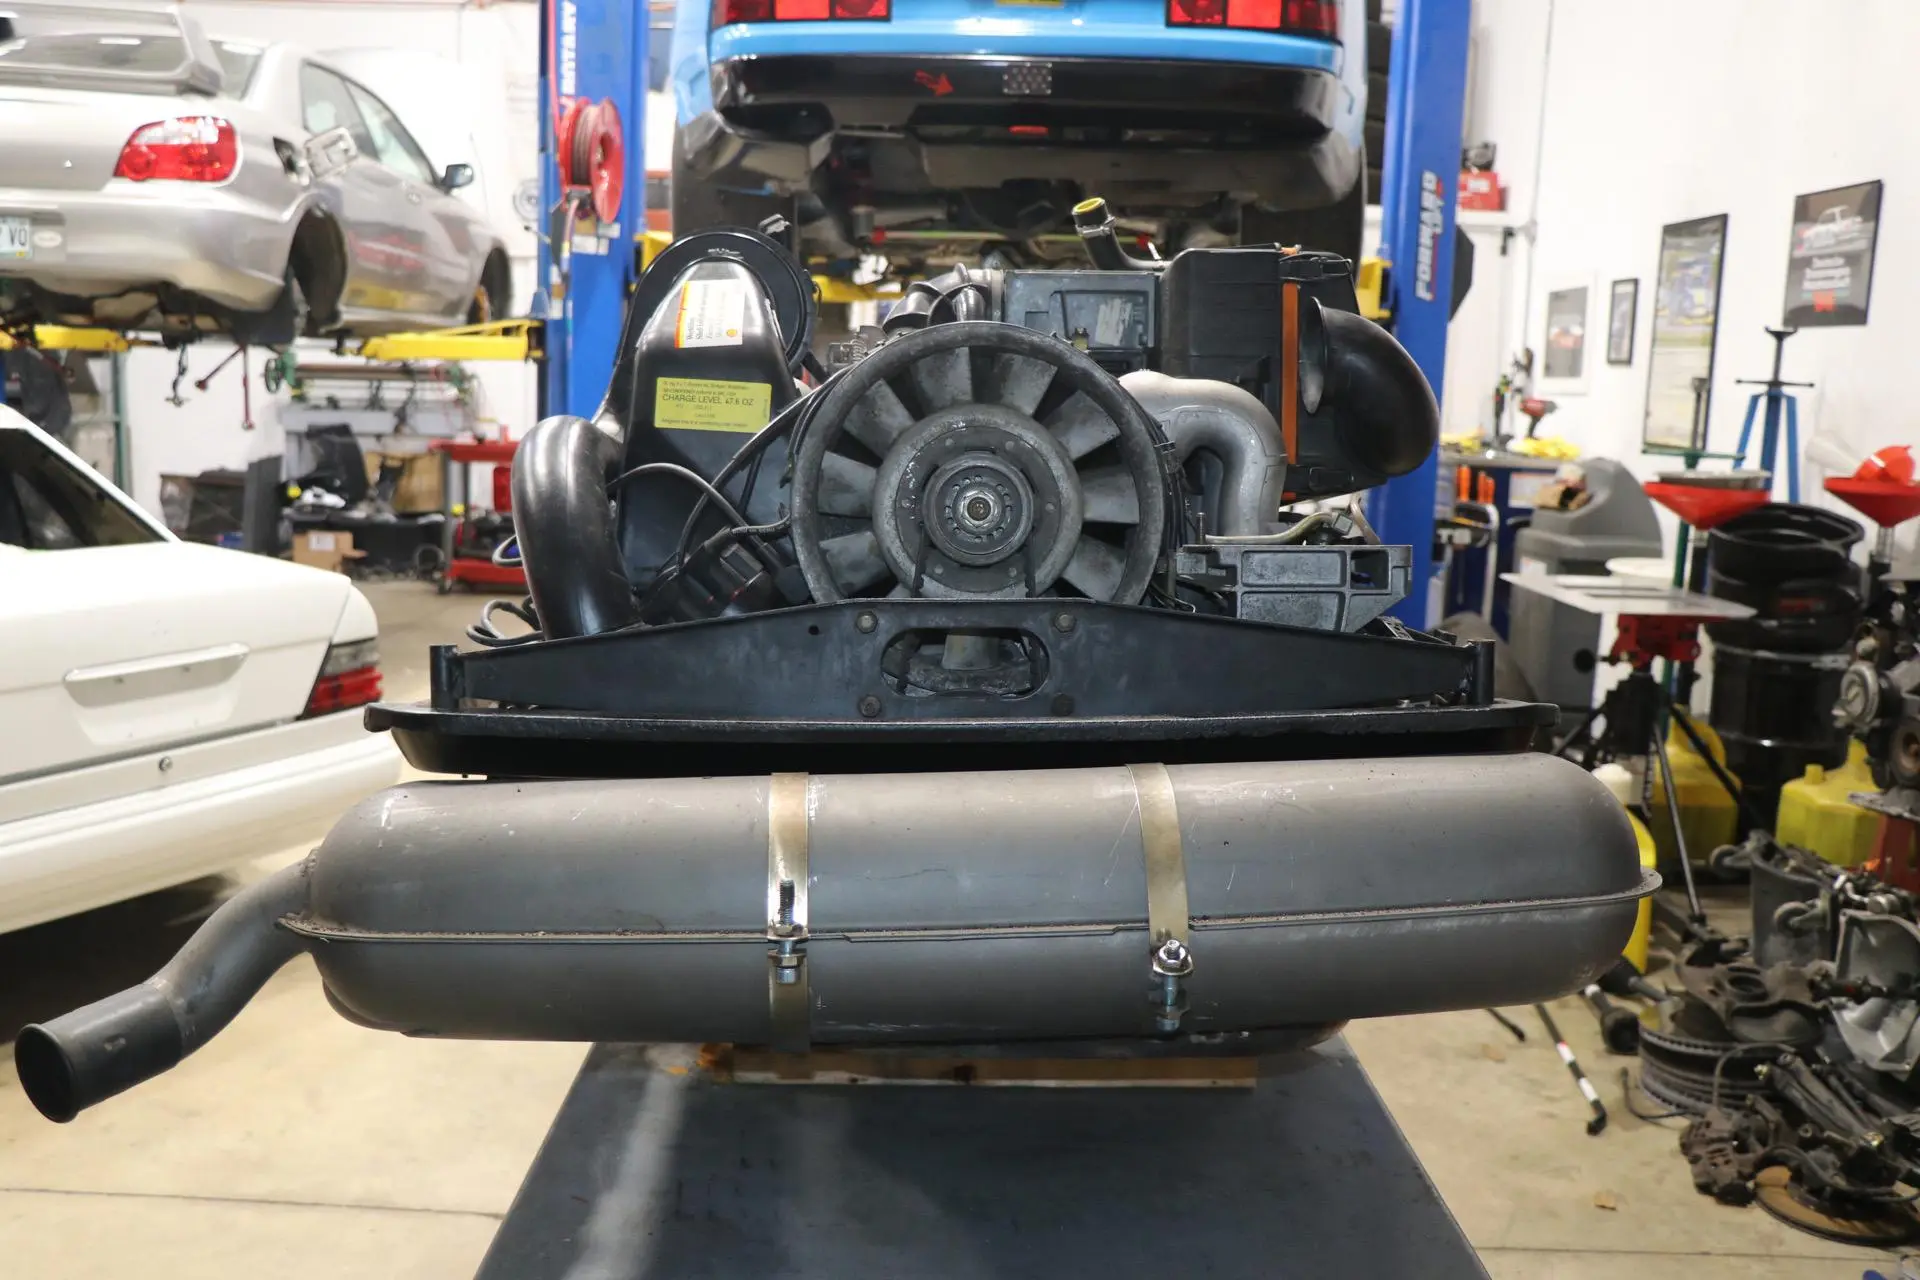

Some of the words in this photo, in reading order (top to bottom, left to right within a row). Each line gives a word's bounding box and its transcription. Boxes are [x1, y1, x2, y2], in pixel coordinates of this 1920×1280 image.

[1415, 170, 1437, 301] FORWARD
[663, 394, 697, 403] CHARGE
[699, 396, 722, 404] LEVEL
[741, 398, 754, 406] OZ
